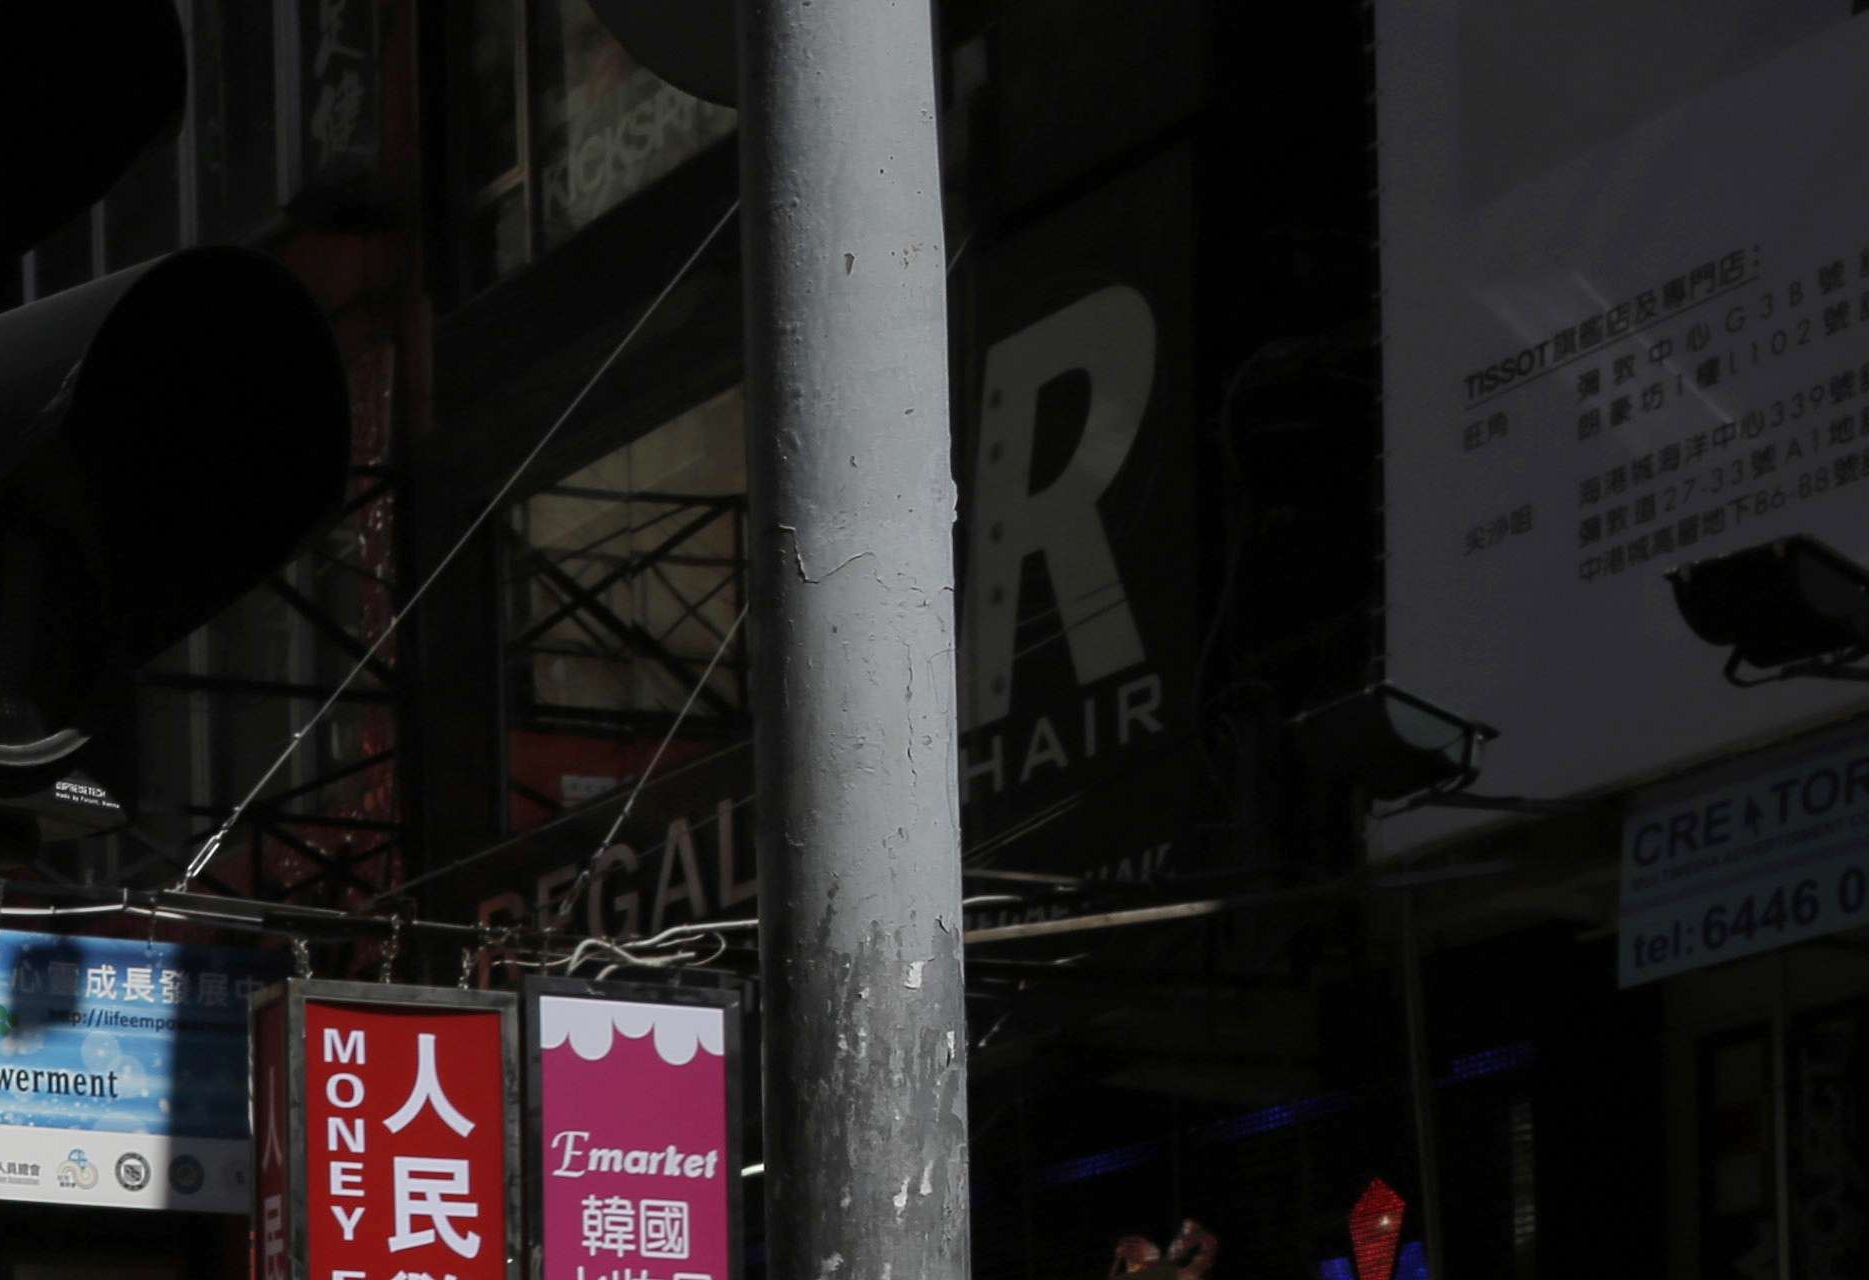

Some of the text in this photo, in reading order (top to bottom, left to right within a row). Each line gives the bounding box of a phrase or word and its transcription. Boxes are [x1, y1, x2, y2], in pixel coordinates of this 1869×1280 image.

[1702, 878, 1818, 950] 6446
[322, 1028, 366, 1242] MONEY
[551, 1131, 719, 1178] Emarket
[581, 1195, 690, 1260] 韓國
